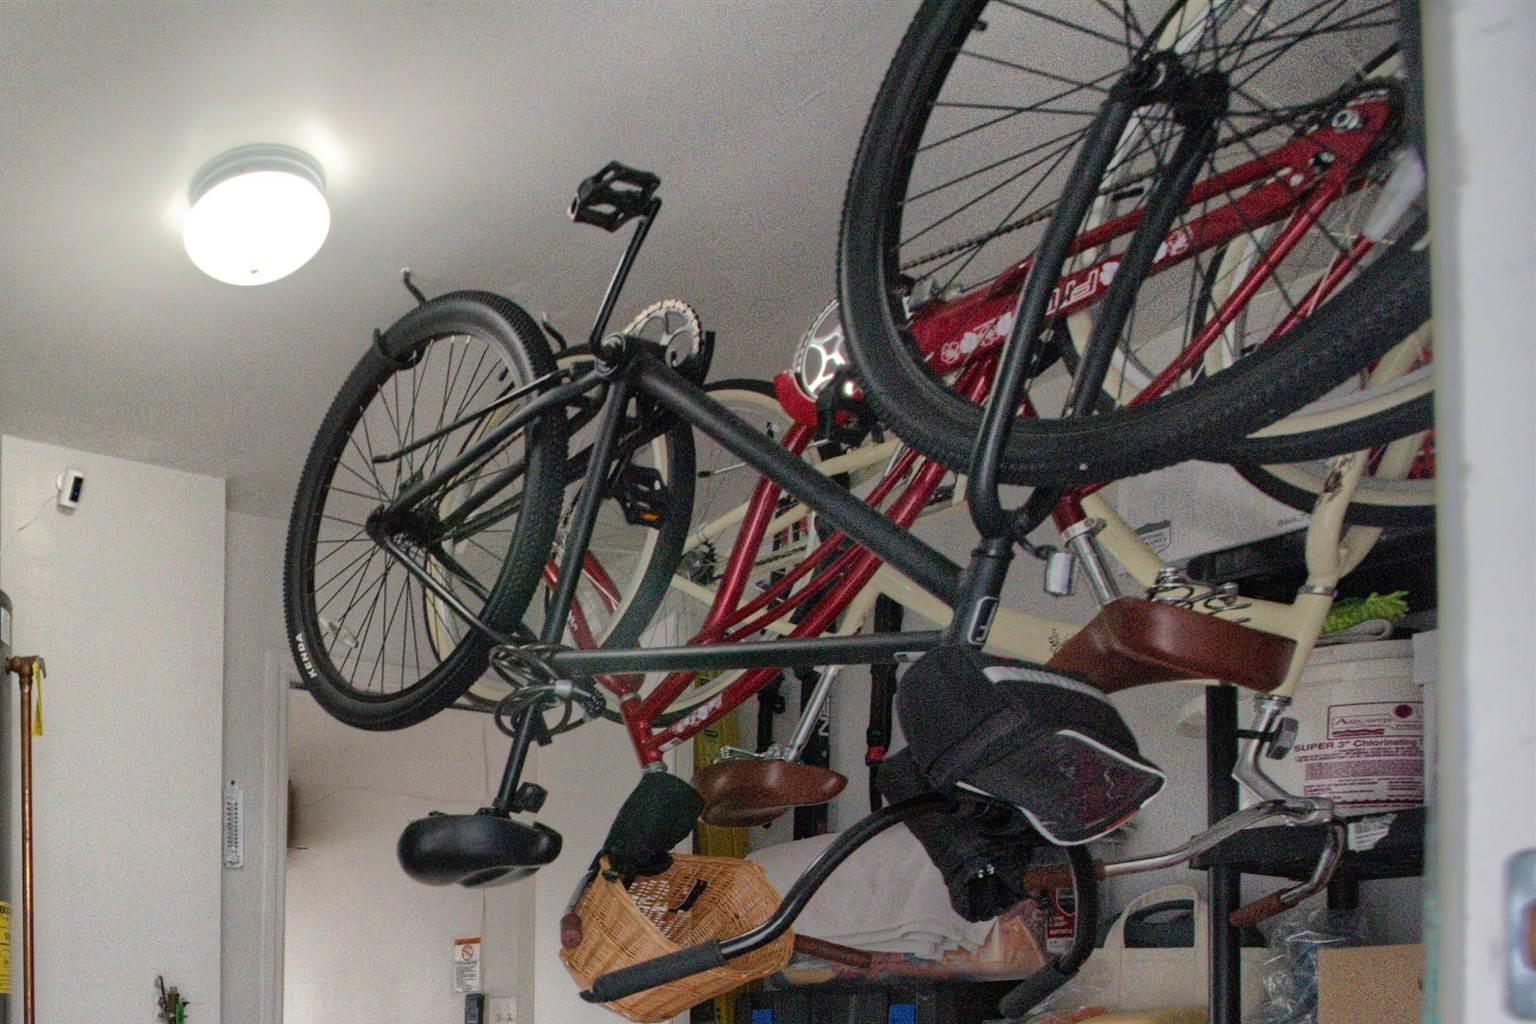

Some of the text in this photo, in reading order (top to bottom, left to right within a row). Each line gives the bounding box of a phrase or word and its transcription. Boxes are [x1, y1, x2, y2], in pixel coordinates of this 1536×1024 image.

[295, 633, 317, 679] KENDA
[1294, 741, 1334, 752] SUPER
[1353, 738, 1417, 749] Chlorinating
